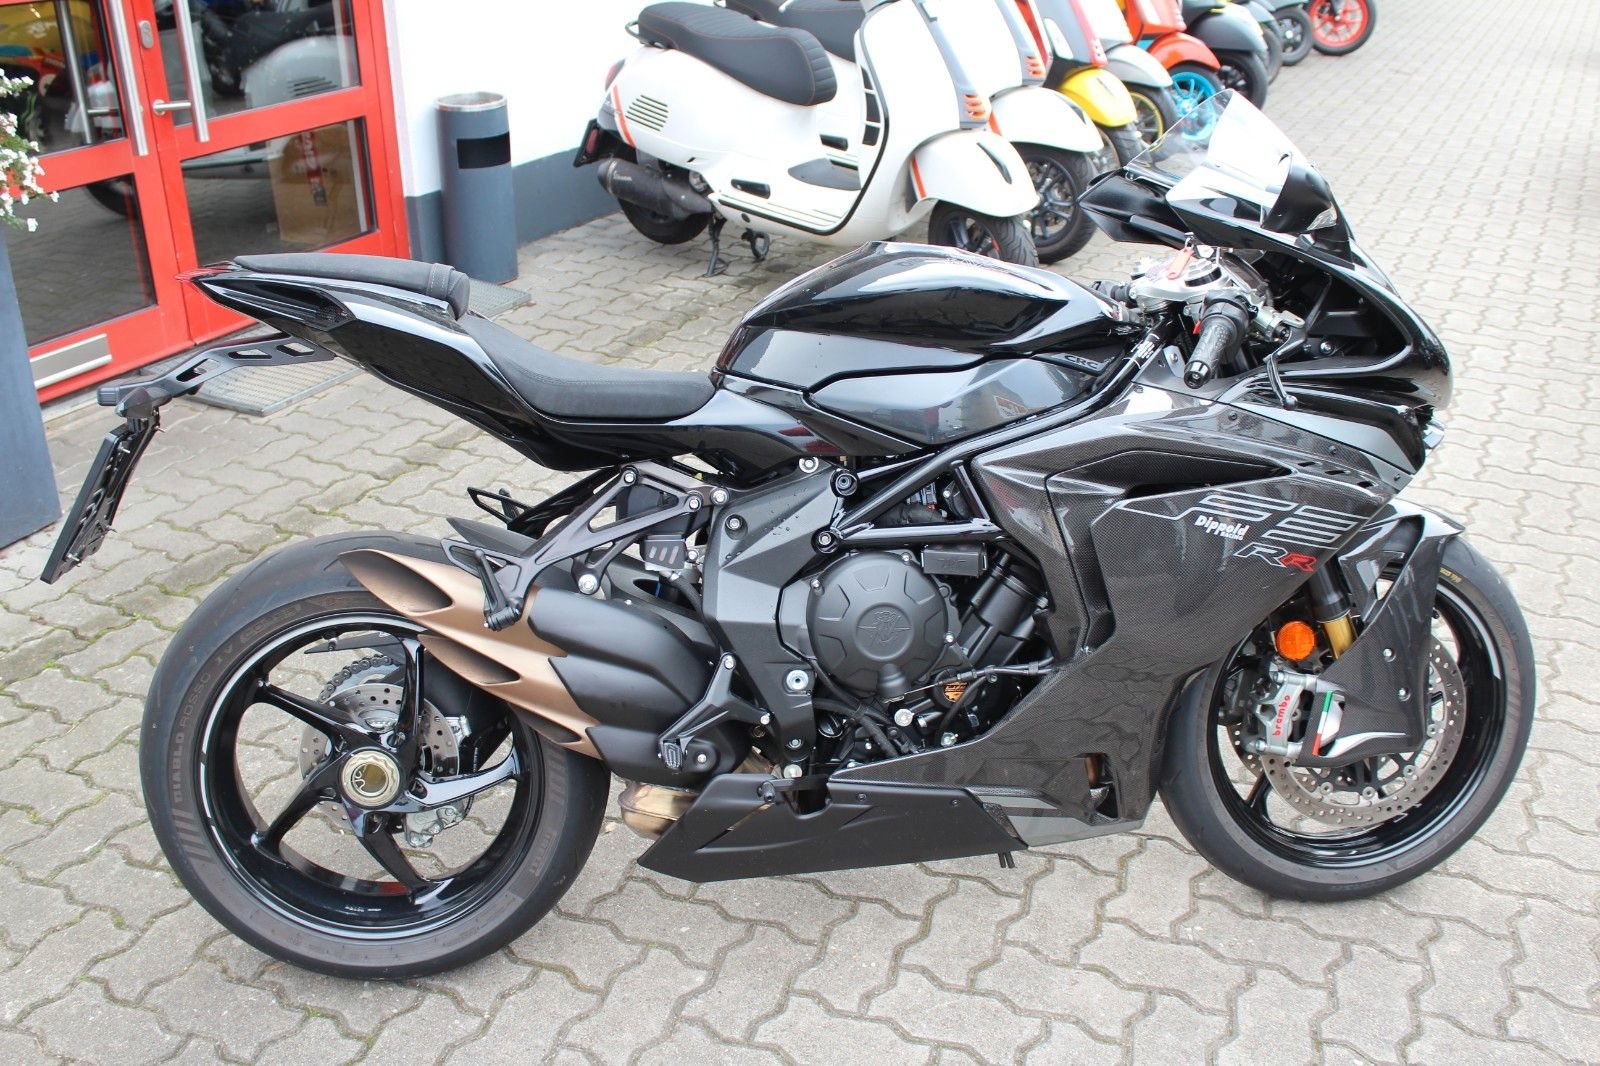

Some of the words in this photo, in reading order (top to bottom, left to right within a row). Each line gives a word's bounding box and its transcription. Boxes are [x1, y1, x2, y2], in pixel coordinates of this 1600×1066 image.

[1064, 354, 1099, 369] CRC
[1194, 514, 1250, 539] Dippold
[1233, 541, 1318, 572] RR
[177, 670, 212, 730] ROSSO
[171, 731, 185, 805] DIABLO
